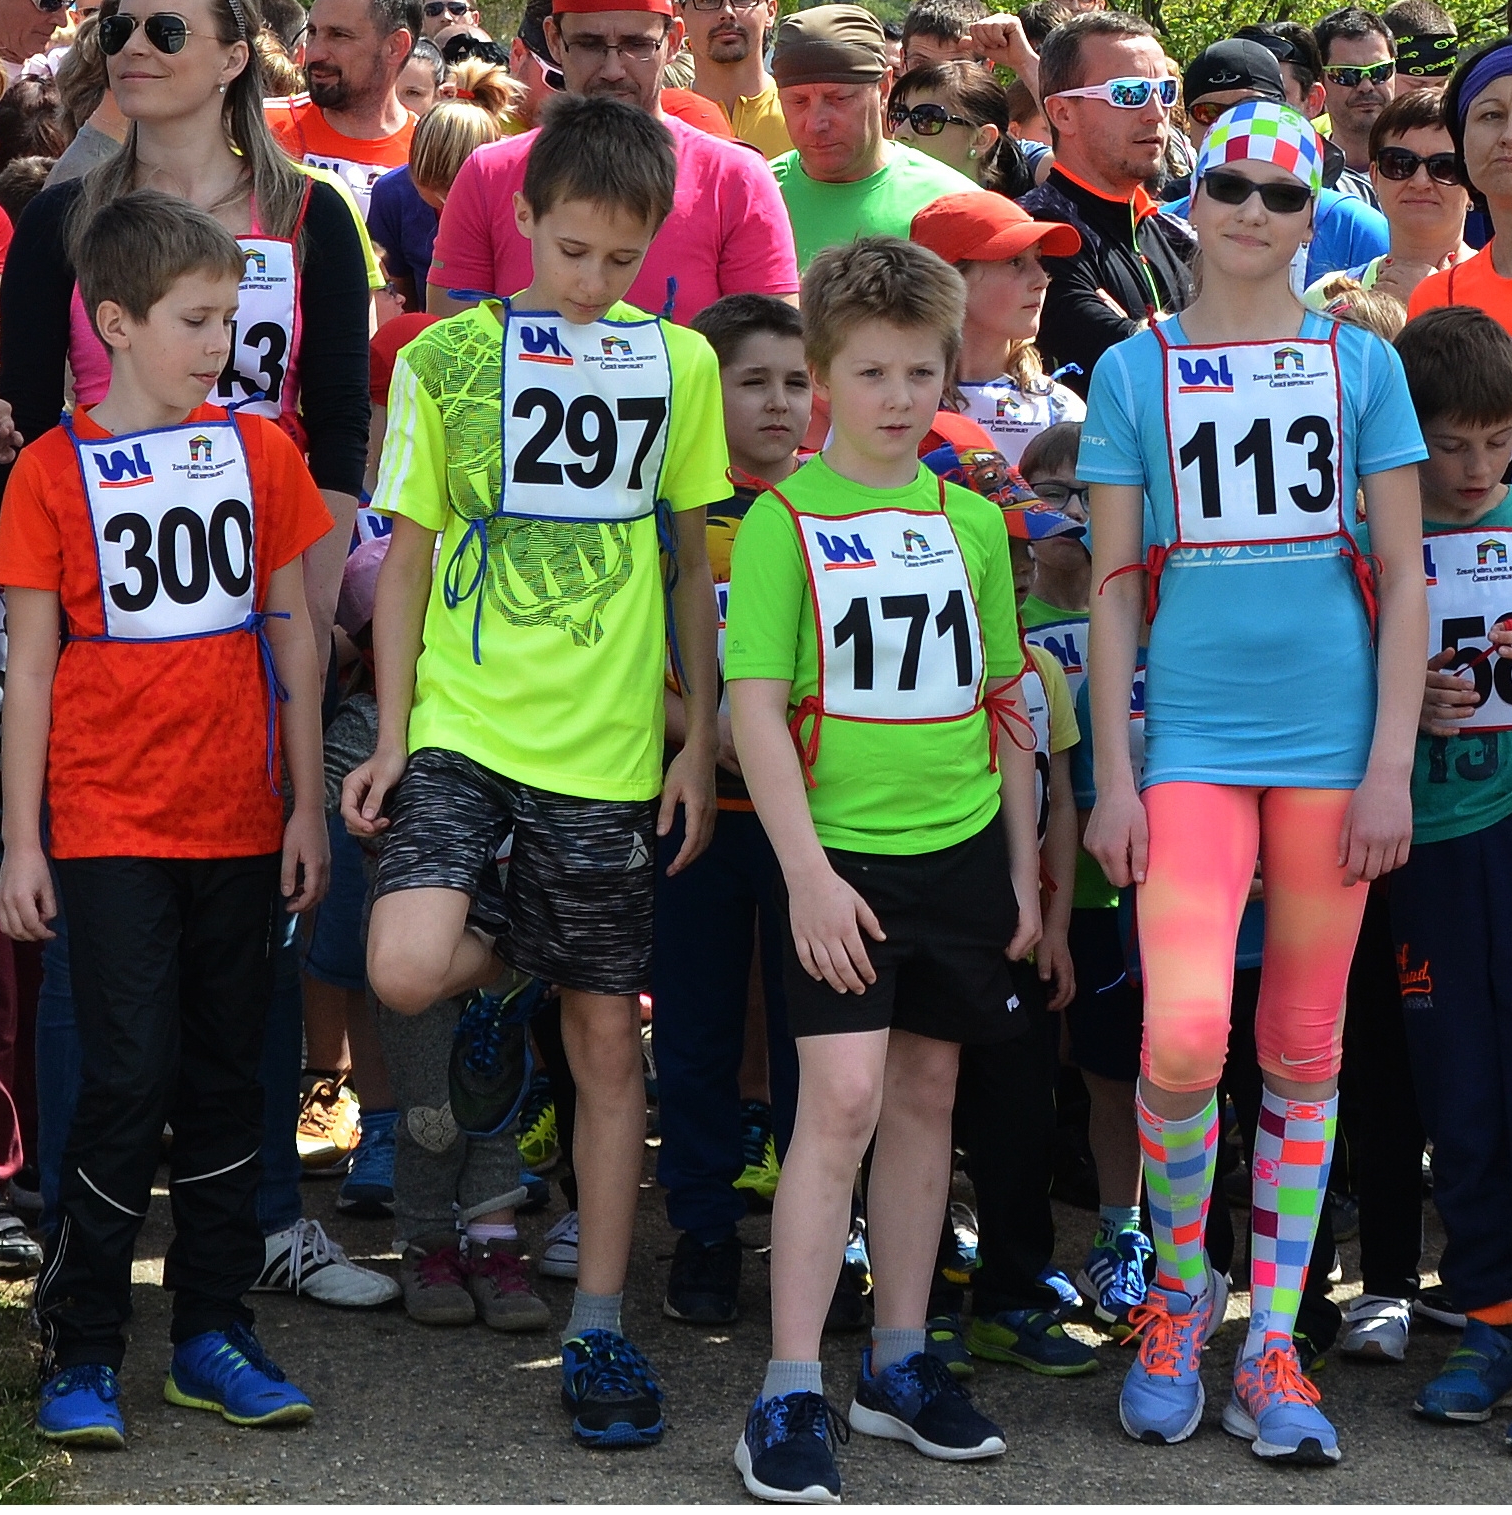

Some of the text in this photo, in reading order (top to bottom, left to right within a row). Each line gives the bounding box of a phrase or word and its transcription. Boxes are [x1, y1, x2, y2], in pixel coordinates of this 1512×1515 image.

[511, 387, 667, 490] 297
[1179, 415, 1337, 519] 113
[103, 498, 253, 613] 300
[833, 589, 974, 692] 171
